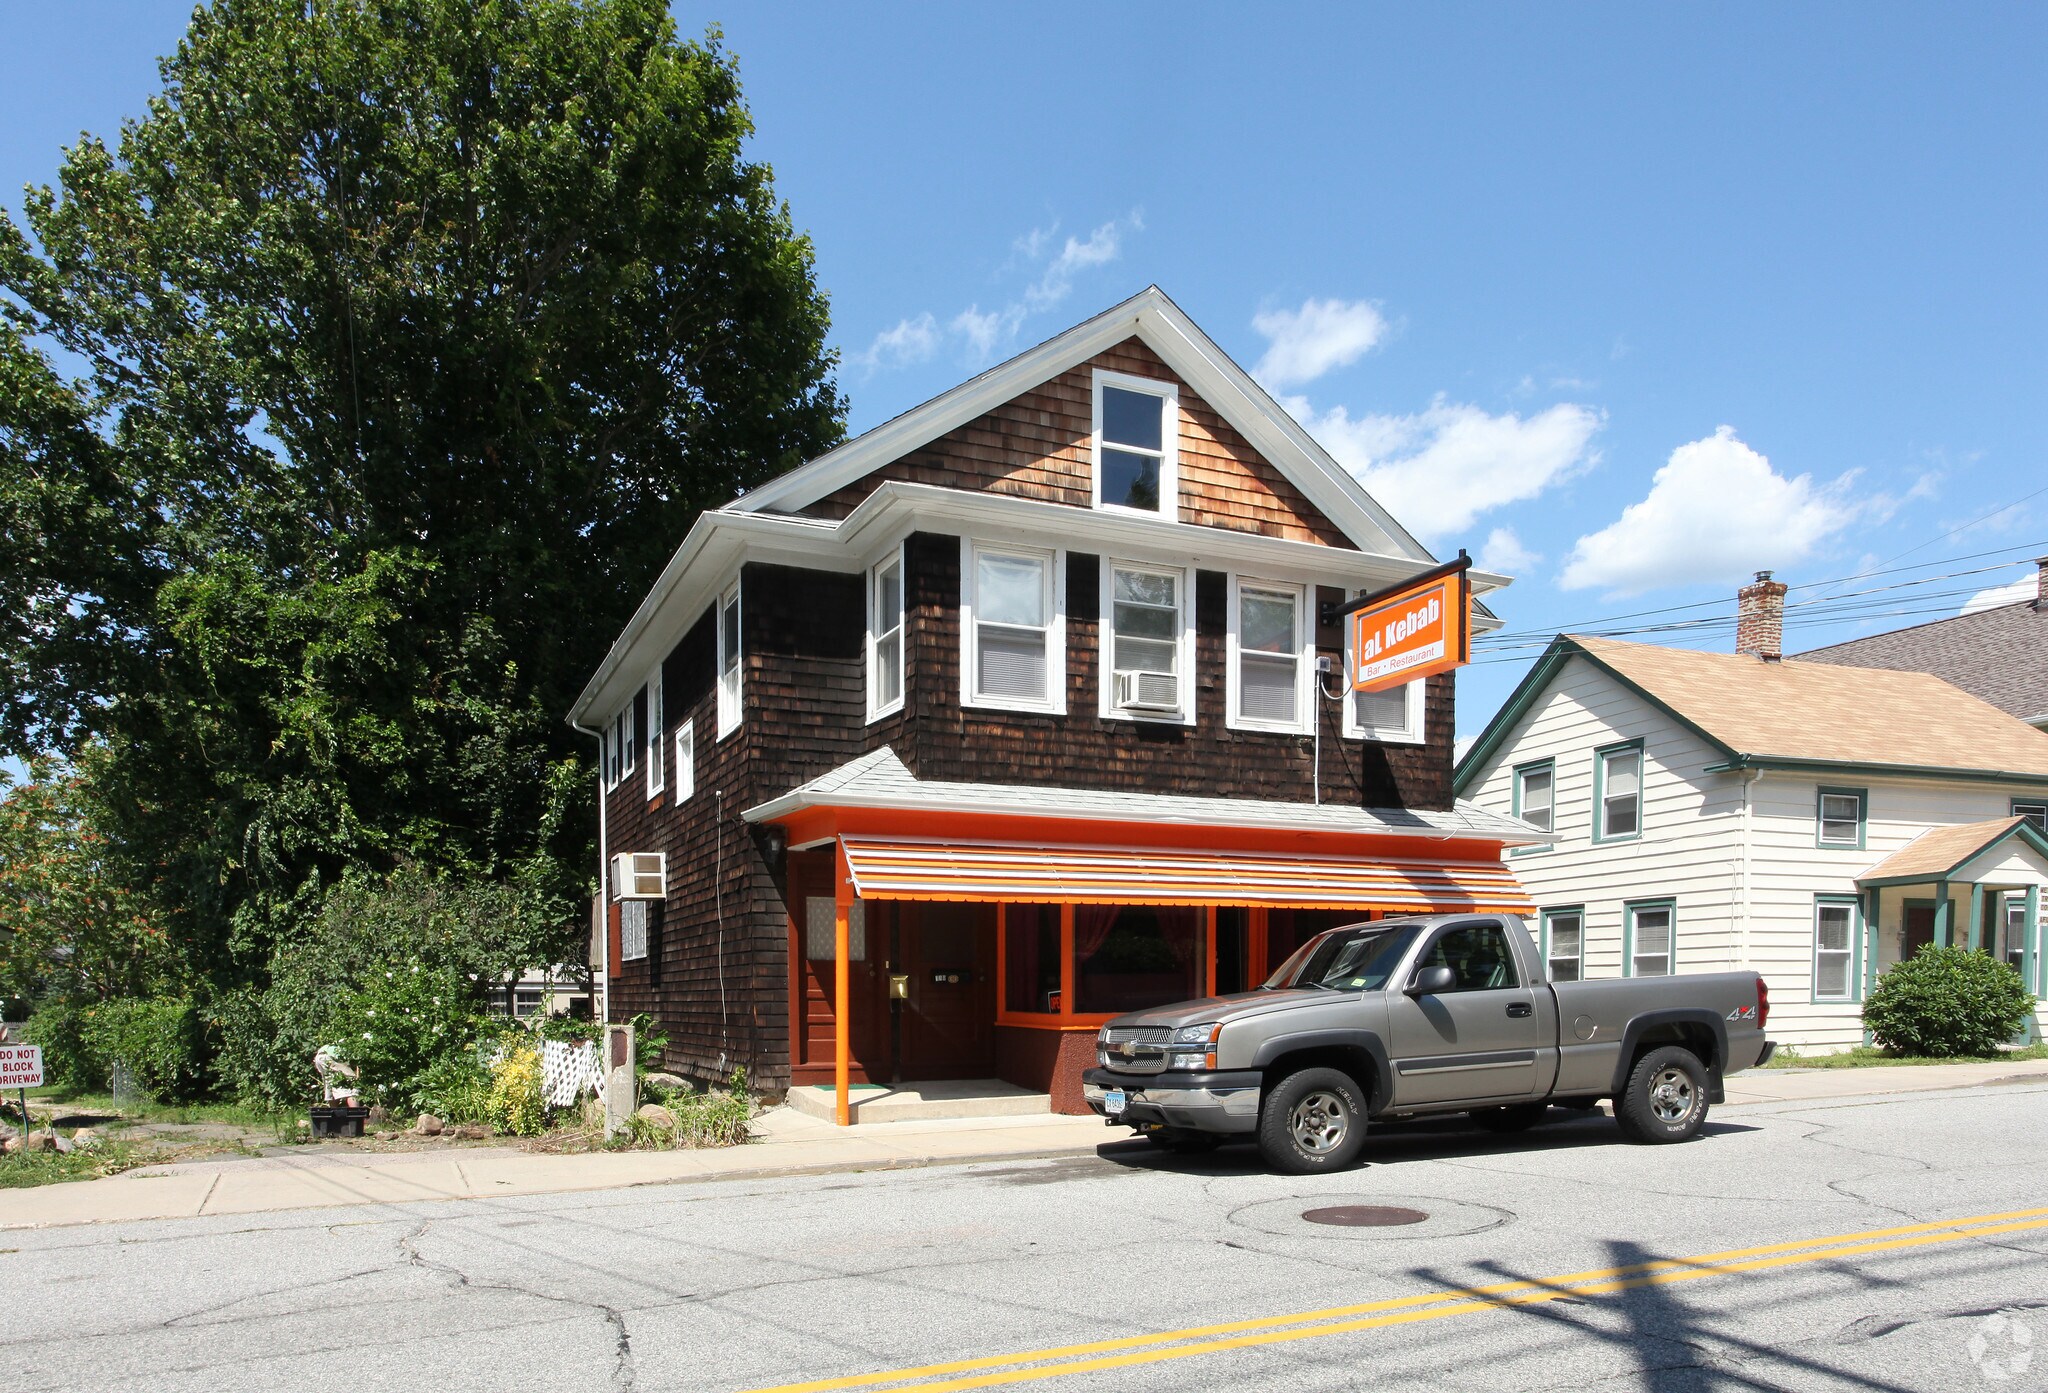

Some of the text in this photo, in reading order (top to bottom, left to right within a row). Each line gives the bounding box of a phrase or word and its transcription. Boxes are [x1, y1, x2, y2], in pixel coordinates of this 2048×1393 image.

[1385, 598, 1440, 649] Kebab
[1367, 647, 1435, 677] Bar Restaurant
[0, 1049, 35, 1060] DO NOT
[2, 1061, 34, 1072] BLOCK
[1689, 1085, 1704, 1124] SAFARI
